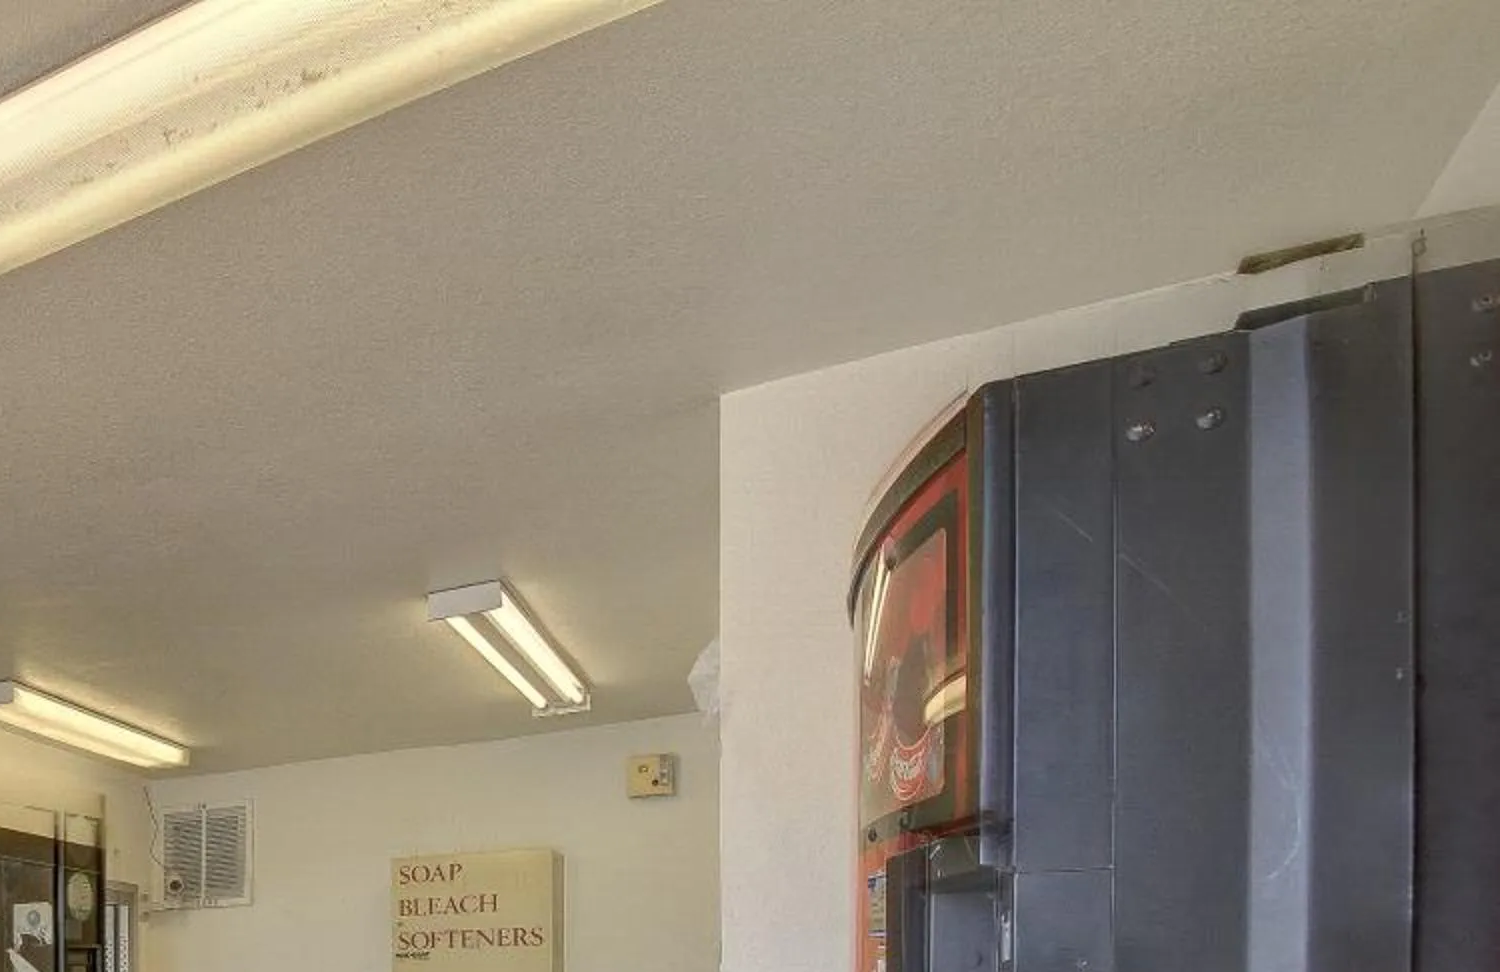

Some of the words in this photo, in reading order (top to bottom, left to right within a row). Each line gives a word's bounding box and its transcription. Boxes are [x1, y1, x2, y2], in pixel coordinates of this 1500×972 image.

[399, 863, 462, 885] SOAP
[399, 894, 498, 917] BLEACH
[398, 927, 543, 950] SOFTENERS
